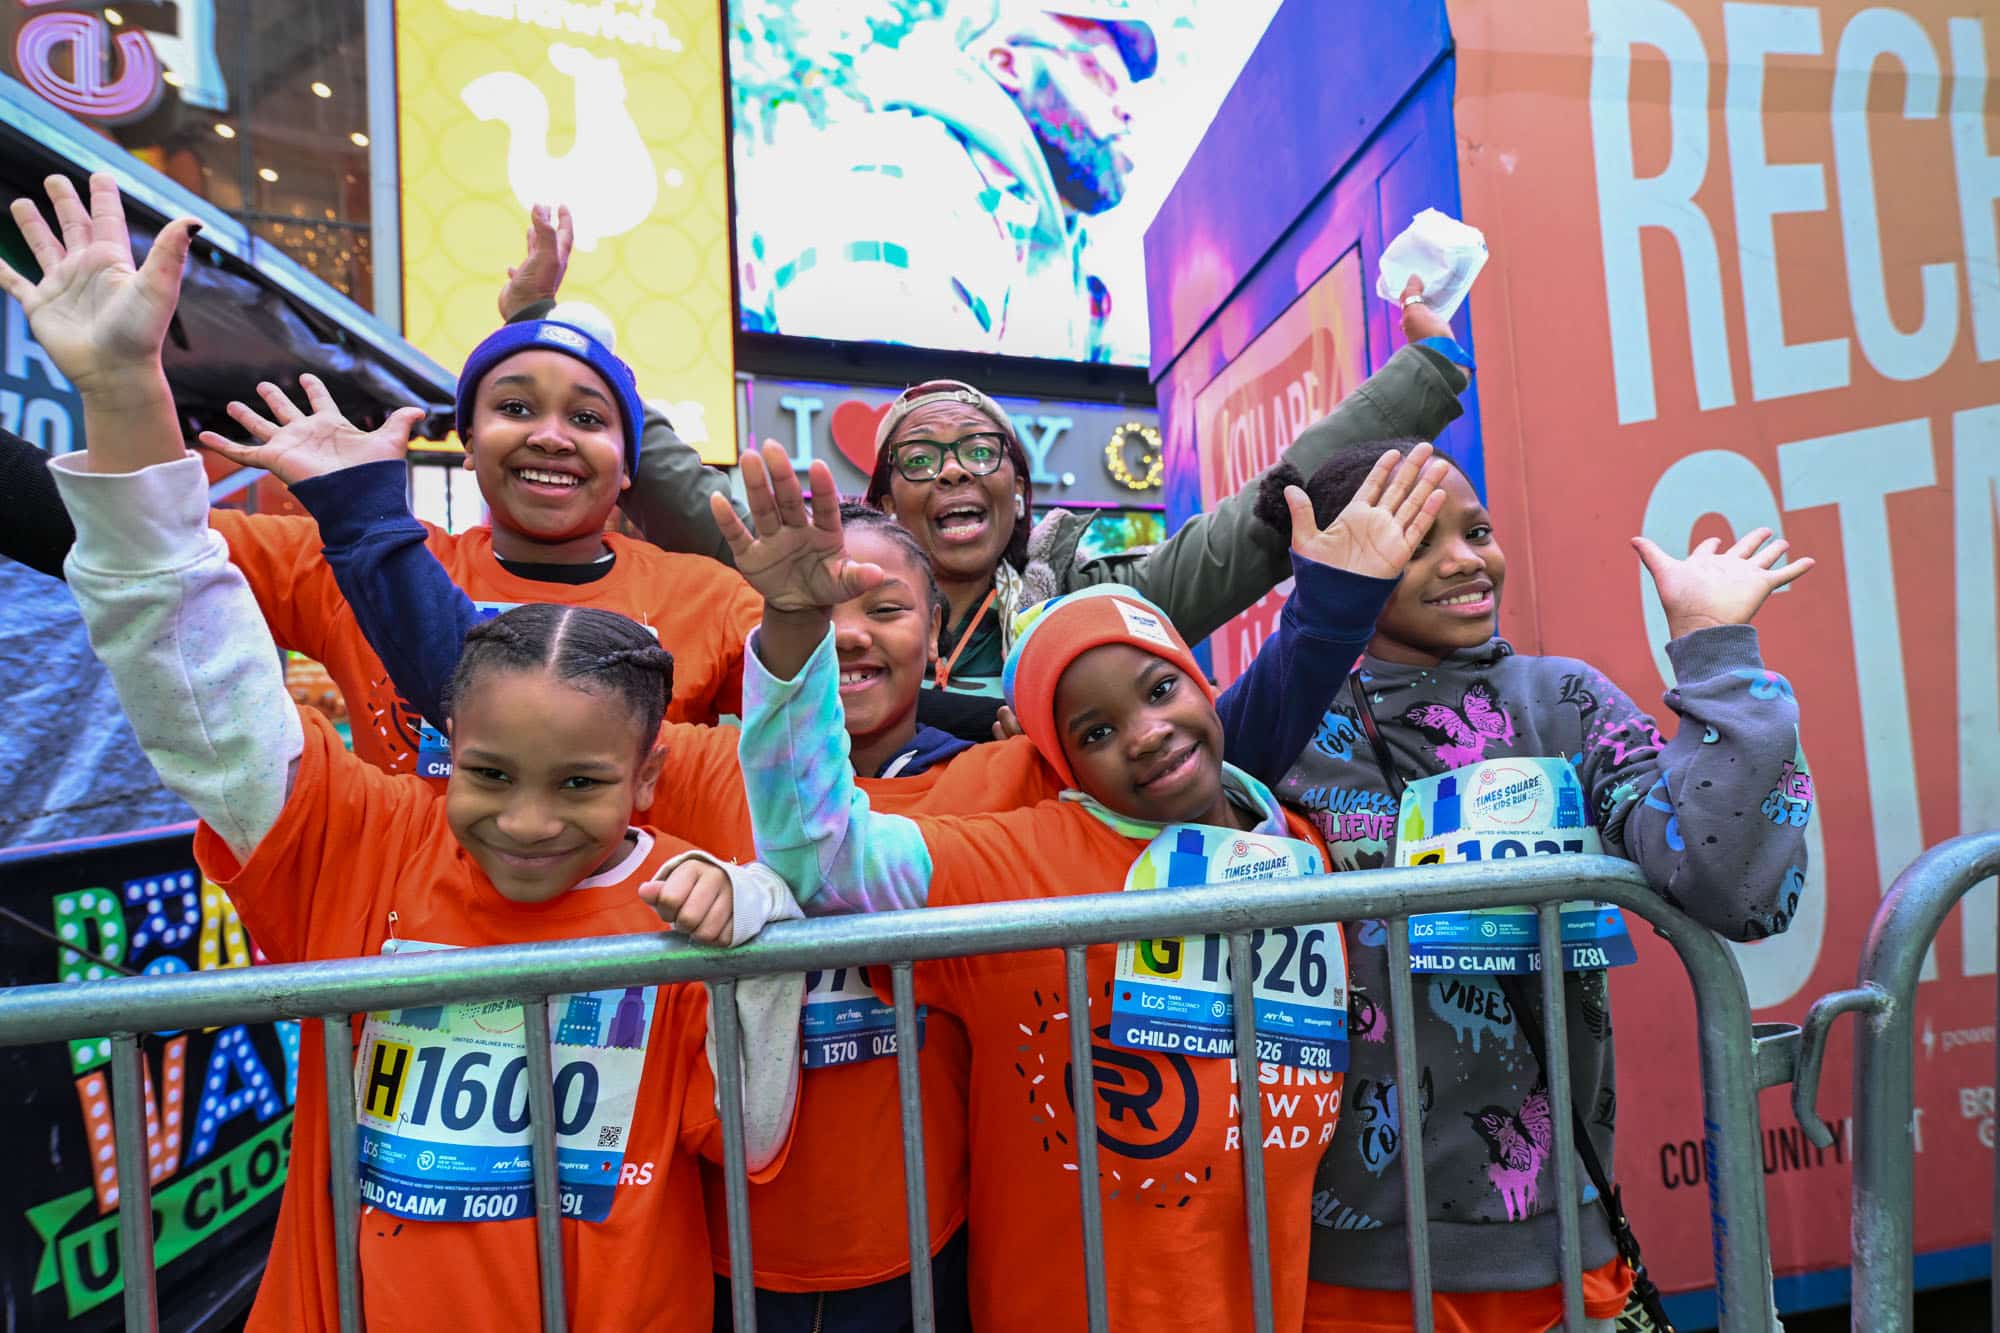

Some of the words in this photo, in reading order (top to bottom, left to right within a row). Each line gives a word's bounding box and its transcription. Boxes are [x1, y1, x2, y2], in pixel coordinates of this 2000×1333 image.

[780, 396, 824, 470] I
[1301, 786, 1400, 815] ALWAYS
[1475, 788, 1503, 809] TIMES
[1504, 776, 1539, 797] SQUARE
[1224, 864, 1251, 879] TIMES
[1252, 856, 1287, 874] SQUARE
[1141, 936, 1180, 973] G
[1460, 956, 1515, 971] CLAIM
[1141, 992, 1165, 1010] tcs
[823, 1041, 858, 1064] 1370
[1126, 1028, 1180, 1048] CHILD
[1183, 1036, 1233, 1054] CLAIM
[366, 1044, 408, 1117] H
[411, 1046, 599, 1136] 1600
[1229, 1093, 1301, 1118] NW
[1225, 1125, 1310, 1152] RAD
[359, 1178, 385, 1204] HILD
[386, 1190, 447, 1216] CLAIM
[463, 1195, 517, 1218] 1600
